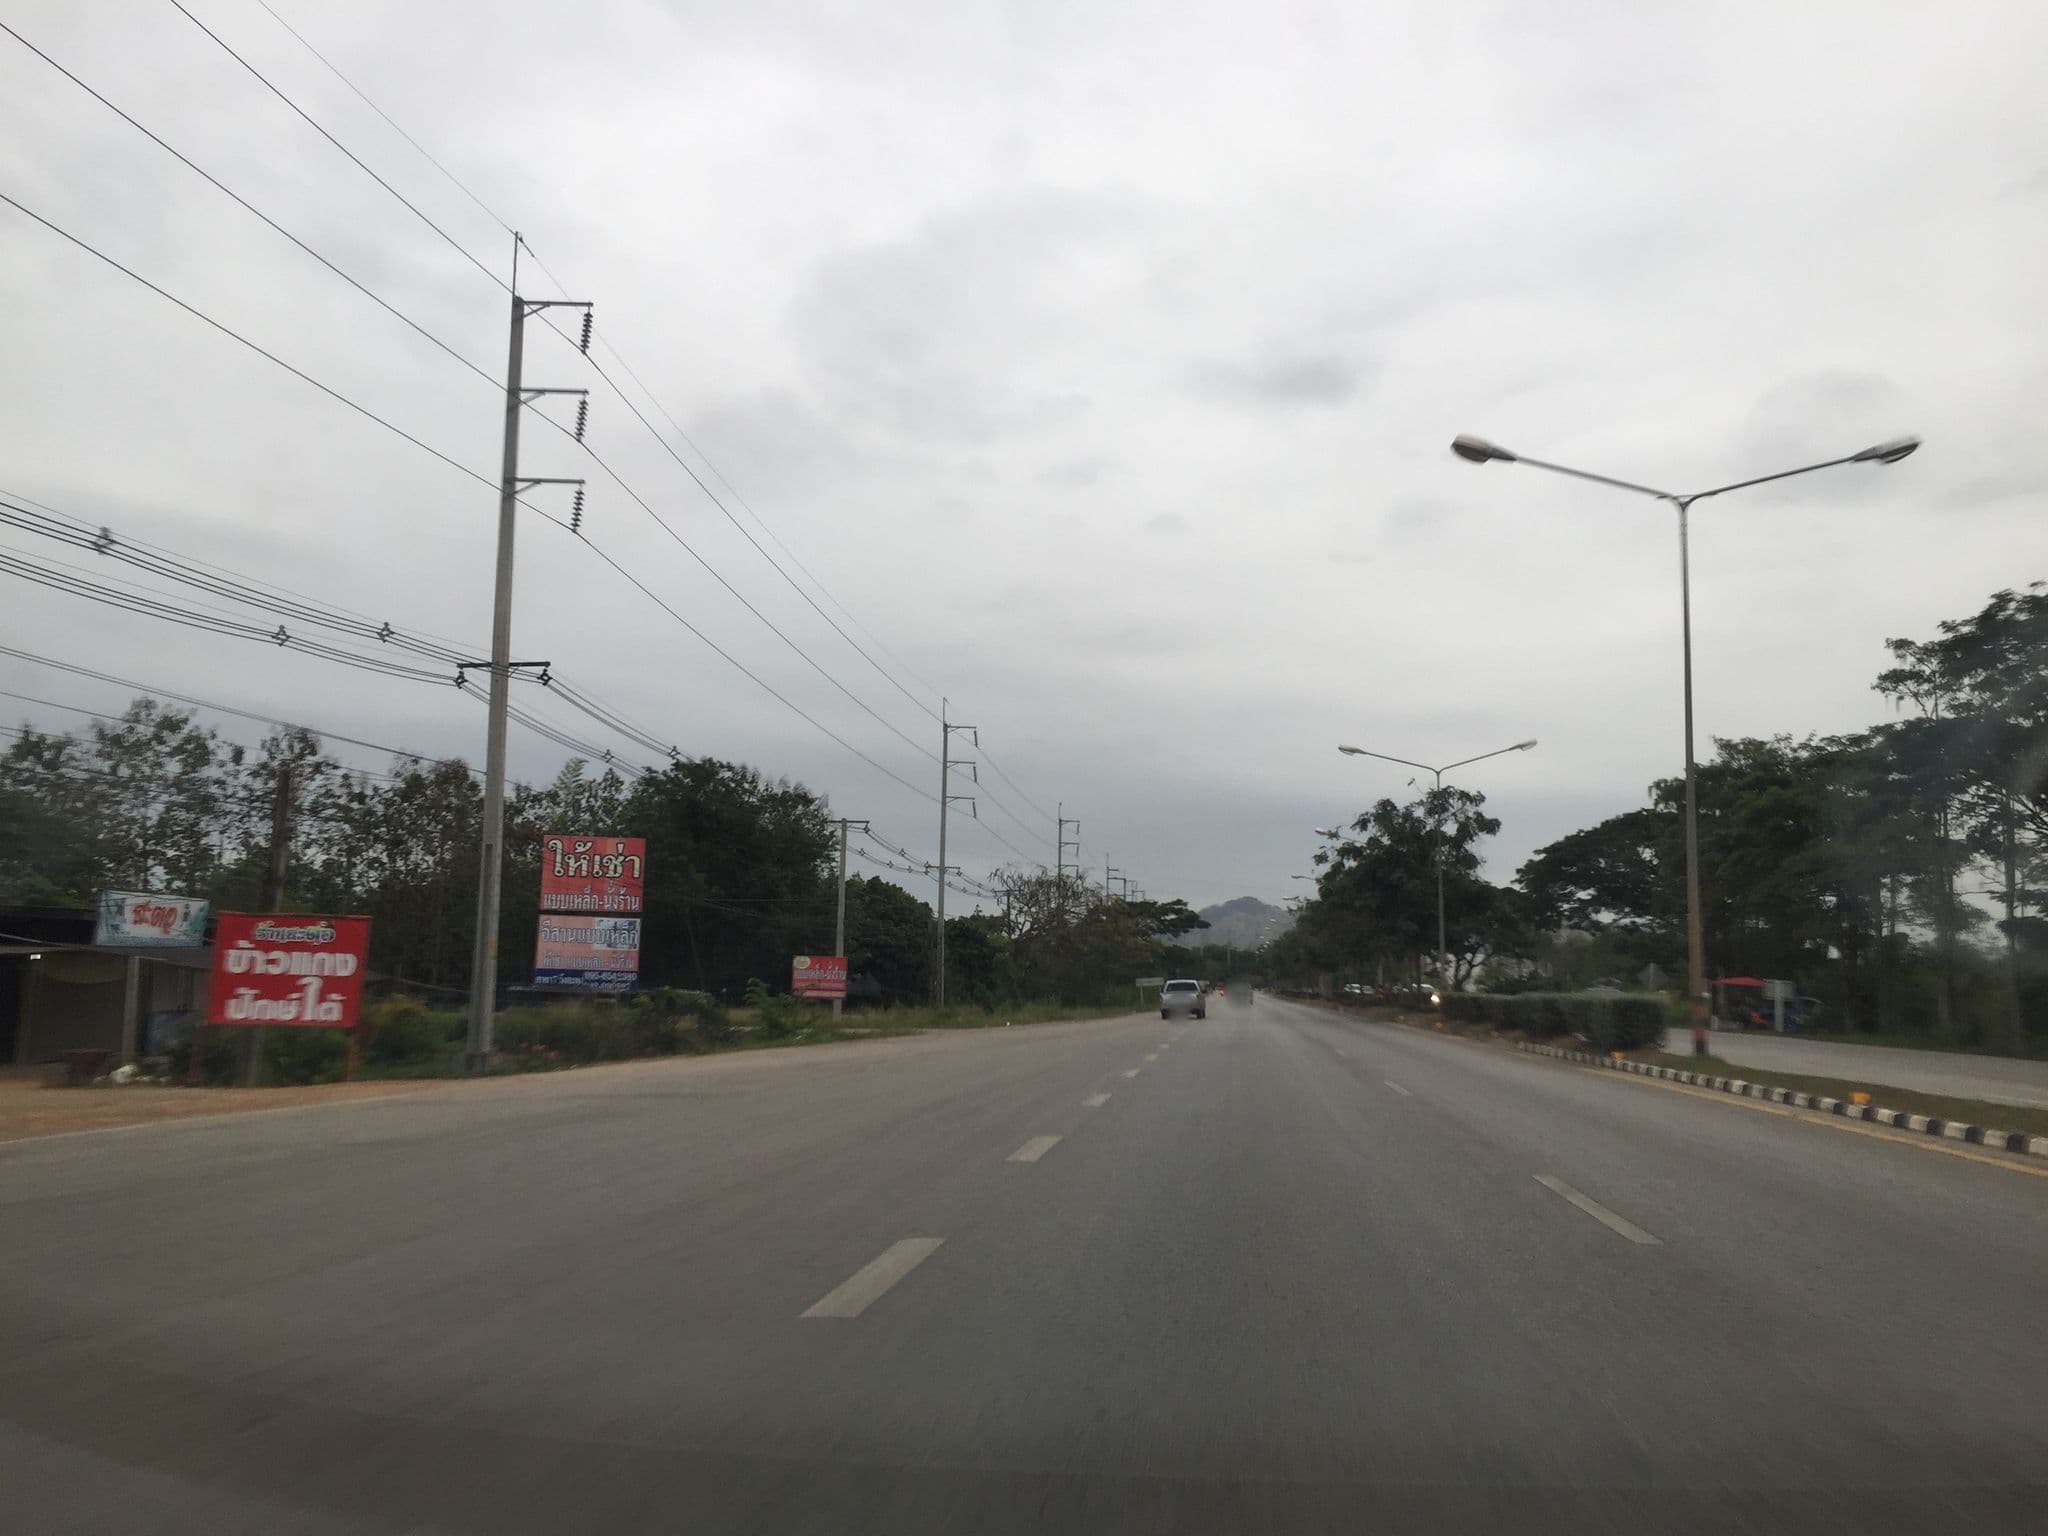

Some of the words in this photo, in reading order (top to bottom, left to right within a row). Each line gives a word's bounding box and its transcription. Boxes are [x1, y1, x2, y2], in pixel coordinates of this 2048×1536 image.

[548, 839, 641, 878] ให้เช่า
[224, 940, 357, 976] ข้าวแกง
[224, 976, 347, 1021] ปักษ์ใต้
